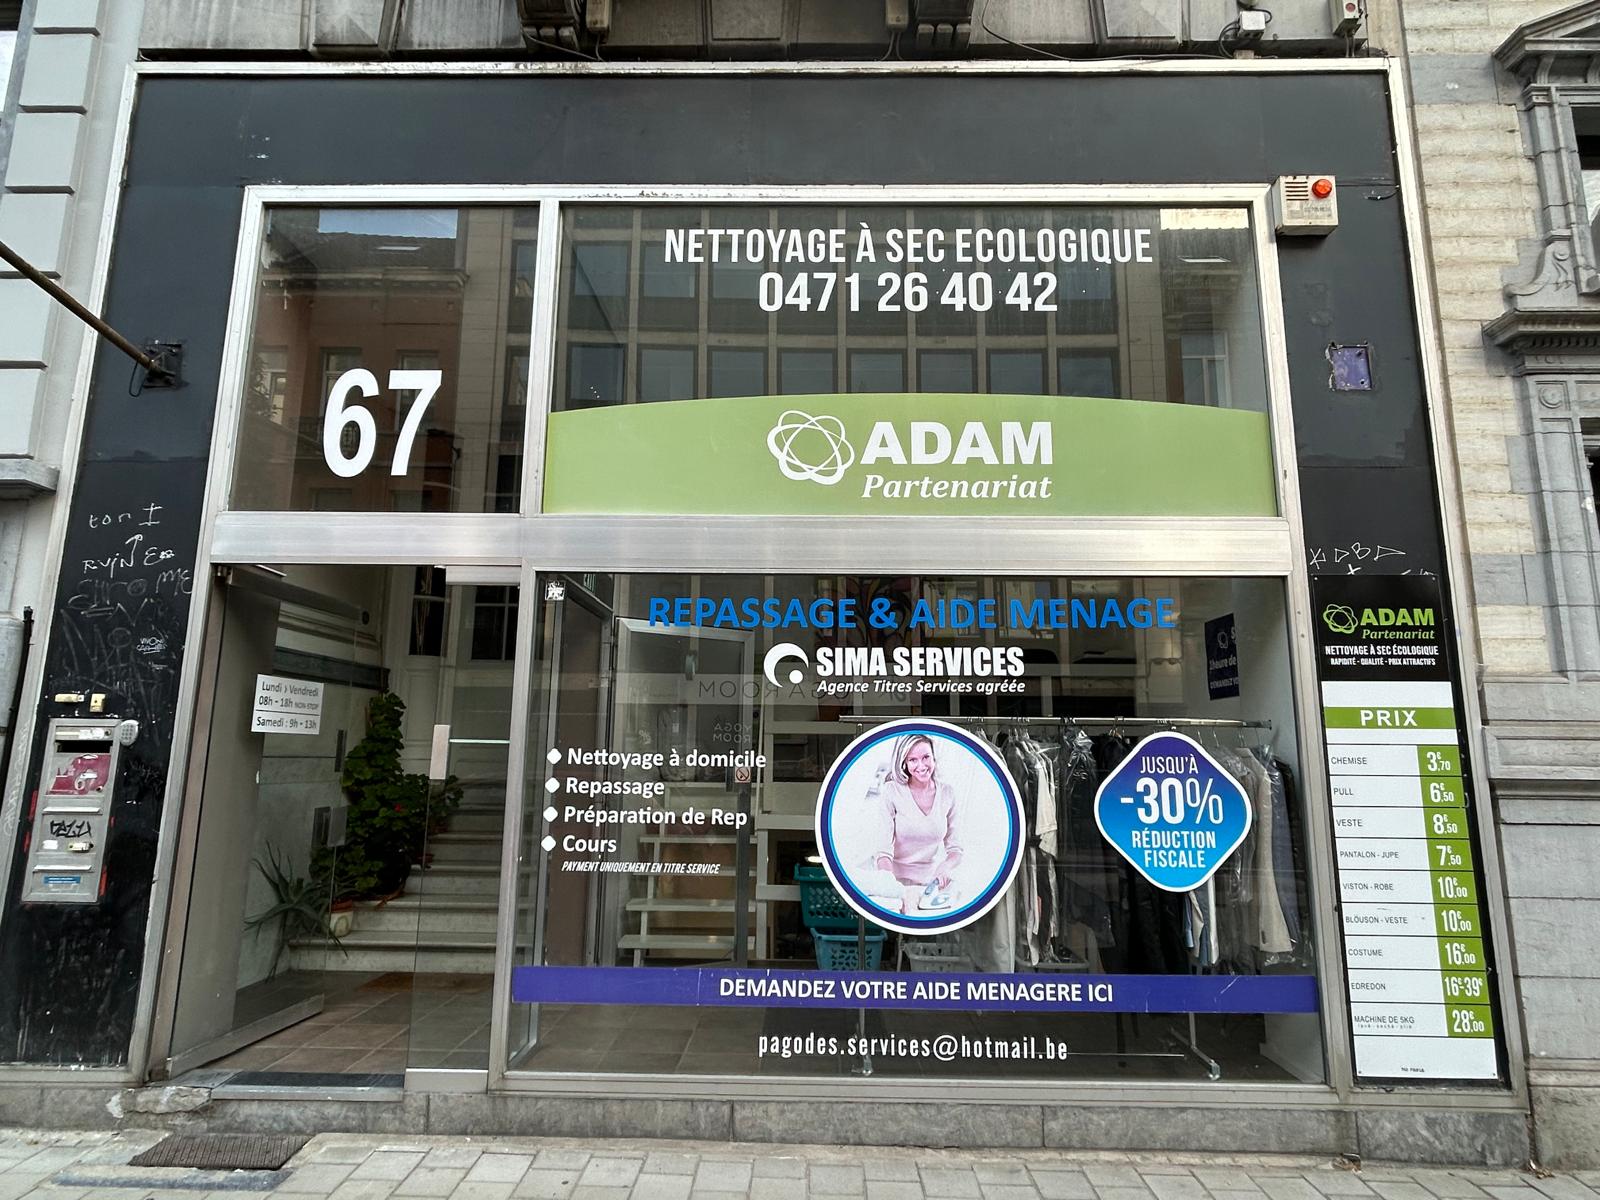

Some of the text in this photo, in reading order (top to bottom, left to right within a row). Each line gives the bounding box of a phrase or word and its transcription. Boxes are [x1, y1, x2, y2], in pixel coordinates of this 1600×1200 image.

[664, 222, 1152, 265] NETTOYAGE À SEC ECOLOGIQUE
[759, 272, 1058, 312] 0471 26 40 42
[323, 367, 442, 478] 67
[860, 421, 1053, 465] ADAM
[861, 474, 1052, 499] Partenariat
[649, 597, 1177, 629] REPASSAGE & AIDE MENAGE
[1360, 608, 1435, 626] ADAM
[1362, 629, 1435, 640] Partenariat
[1325, 643, 1439, 656] NETTOYAGE À SEC ÉCOLOGIQUE
[816, 646, 1024, 678] SIMA SERVICES
[1330, 657, 1356, 666] RAPIDITÉ
[1360, 657, 1384, 666] QUALITÉ
[1388, 657, 1402, 666] PRIX
[1402, 657, 1436, 666] ATTRACTIFS
[262, 681, 319, 697] Lundi Vendredi
[817, 679, 1025, 696] Agence Titres Services agréée
[258, 696, 273, 706] 08h
[280, 698, 293, 708] 18h
[256, 716, 284, 727] Samedi
[289, 718, 298, 728] 9h
[304, 720, 317, 729] 13h
[1360, 709, 1418, 727] PRIX
[567, 748, 766, 769] Nettoyage à domicile
[1140, 754, 1199, 775] JUSQU'À
[1331, 757, 1367, 765] CHEMISE
[566, 777, 665, 798] Repassage
[1333, 787, 1354, 796] PULL
[1120, 777, 1224, 825] -30%
[564, 805, 748, 829] Préparation de Rep
[1336, 819, 1363, 827] VESTE
[562, 835, 617, 853] Cours
[1132, 827, 1216, 849] RÉDUCTION
[1144, 850, 1206, 868] FISCALE
[1339, 851, 1376, 859] PANTALON
[1381, 851, 1400, 859] JUPE
[561, 861, 721, 874] PAYMENT UNIQUEMENT EN TITRE SERVICE
[1374, 883, 1394, 891] ROBE
[1345, 916, 1379, 924] BLOUSON
[1384, 916, 1408, 924] VESTE
[1348, 948, 1383, 957] COSTUME
[720, 978, 1113, 1002] DEMANDEZ VOTRE AIDE MENAGERE ICI
[1351, 982, 1386, 990] EDREDON
[1354, 1015, 1387, 1023] MACHINE
[1388, 1015, 1398, 1024] DE
[758, 1032, 1068, 1061] pagodes.services@hotmail.be
